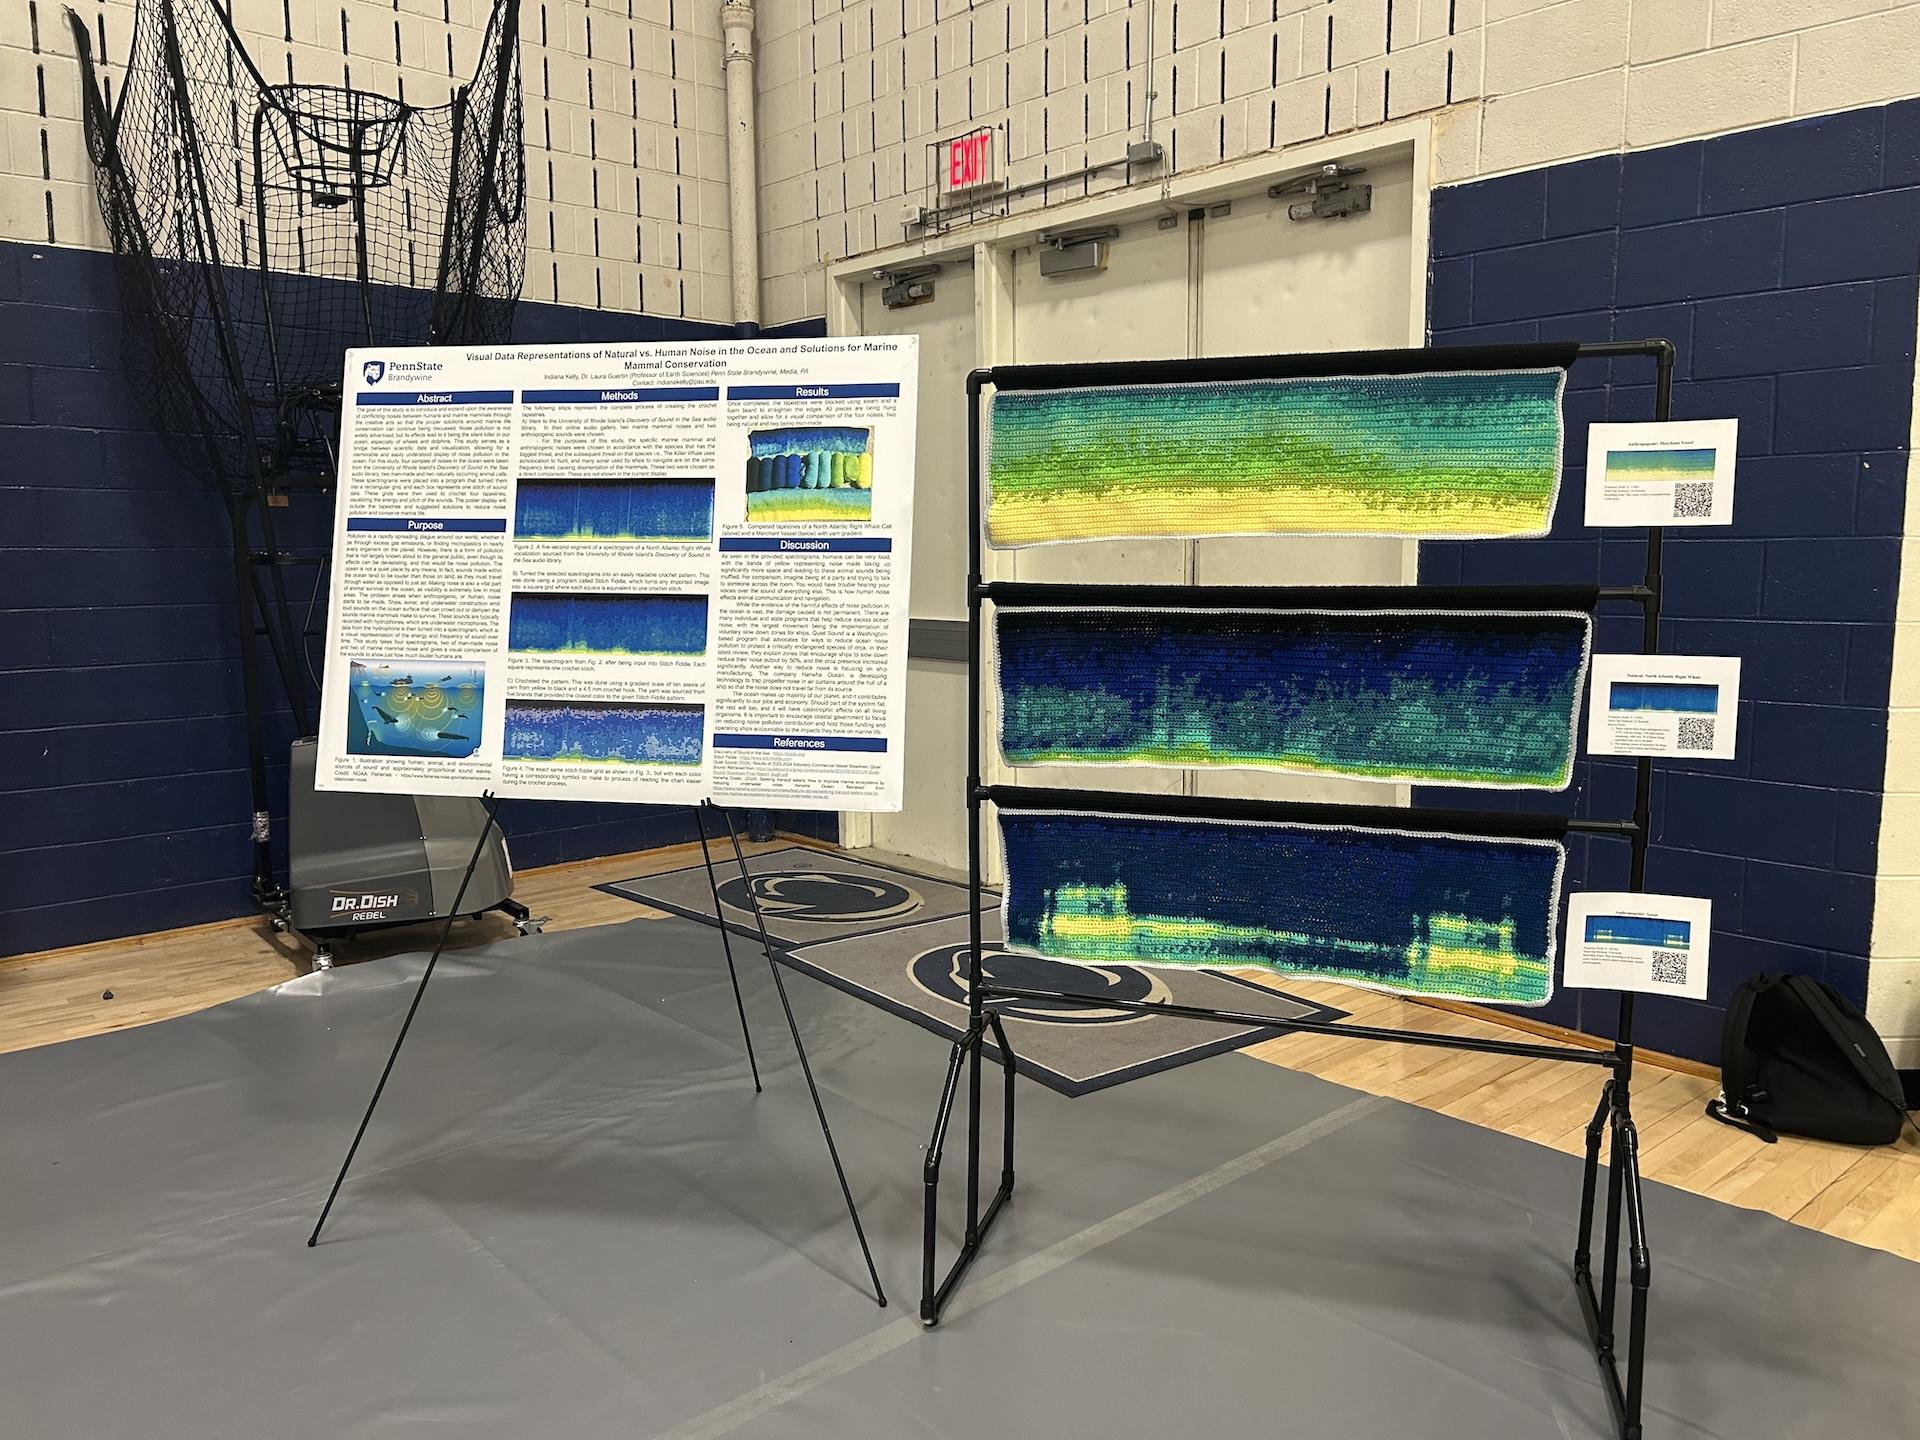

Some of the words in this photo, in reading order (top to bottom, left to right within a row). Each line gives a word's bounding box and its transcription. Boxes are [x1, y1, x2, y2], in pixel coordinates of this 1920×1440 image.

[951, 135, 990, 186] EXIT
[466, 352, 492, 361] Visual
[494, 352, 514, 360] Data
[517, 350, 590, 361] Representations
[593, 350, 602, 358] of
[604, 349, 637, 358] Natural
[654, 348, 686, 356] Human
[690, 347, 715, 356] Noise
[718, 347, 726, 355] in
[729, 347, 744, 355] the
[747, 345, 776, 354] Ocean
[780, 345, 797, 353] and
[800, 343, 844, 353] Solutions
[847, 343, 860, 351] for
[864, 342, 897, 351] Marine
[389, 361, 443, 372] PennState
[624, 361, 662, 369] Mammal
[665, 359, 726, 368] Conservation
[388, 373, 432, 383] Brandywine
[601, 391, 639, 401] Methods
[796, 386, 829, 397] Results
[417, 393, 452, 403] Abstract
[408, 521, 444, 531] Purpose
[780, 540, 830, 550] Discussion
[773, 738, 826, 748] References
[352, 911, 386, 921] REBEL
